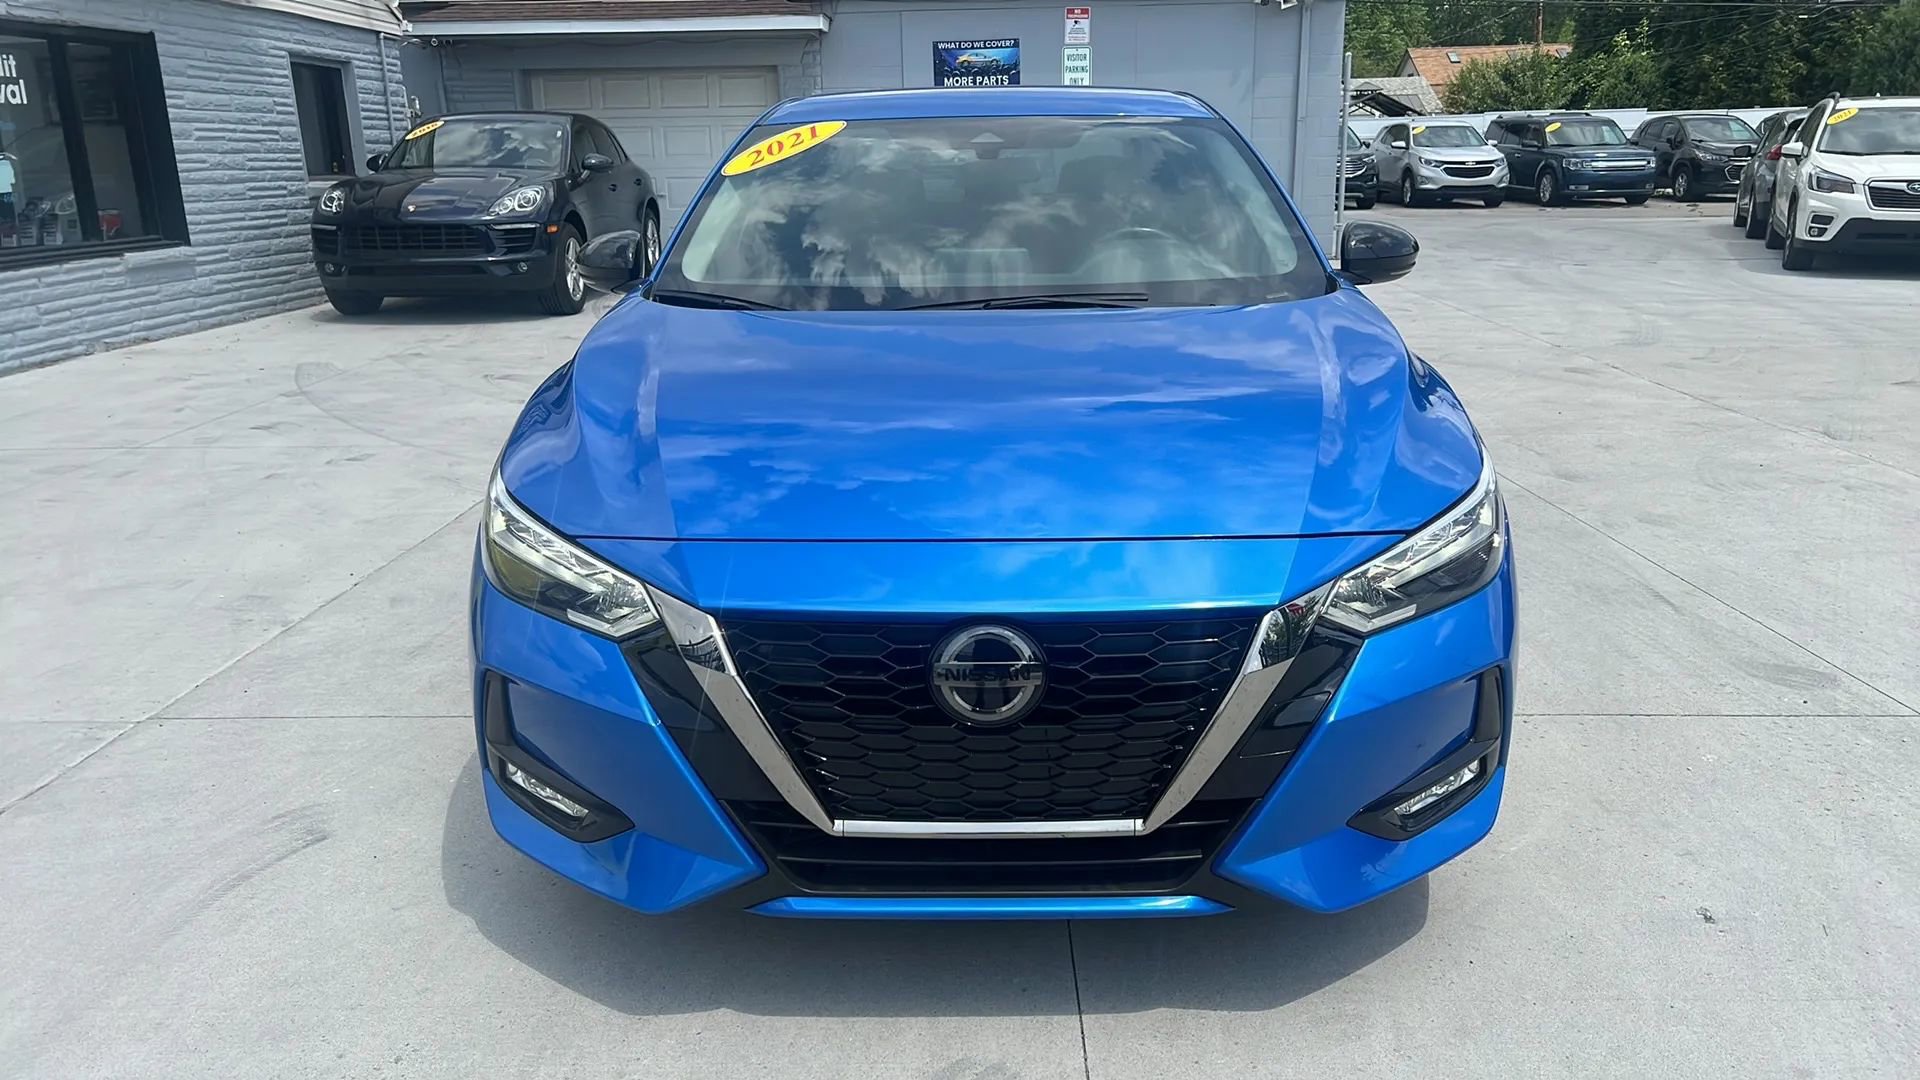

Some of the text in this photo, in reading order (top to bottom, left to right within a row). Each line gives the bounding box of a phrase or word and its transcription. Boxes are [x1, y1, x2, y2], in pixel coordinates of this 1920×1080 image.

[986, 40, 1014, 48] COVER?
[1066, 53, 1087, 61] VISITOR
[1065, 65, 1088, 73] PARKING
[944, 75, 1009, 87] MORE PARTS
[1069, 77, 1084, 85] ONLY
[747, 125, 818, 166] 2021
[944, 667, 1031, 681] NISSAN
